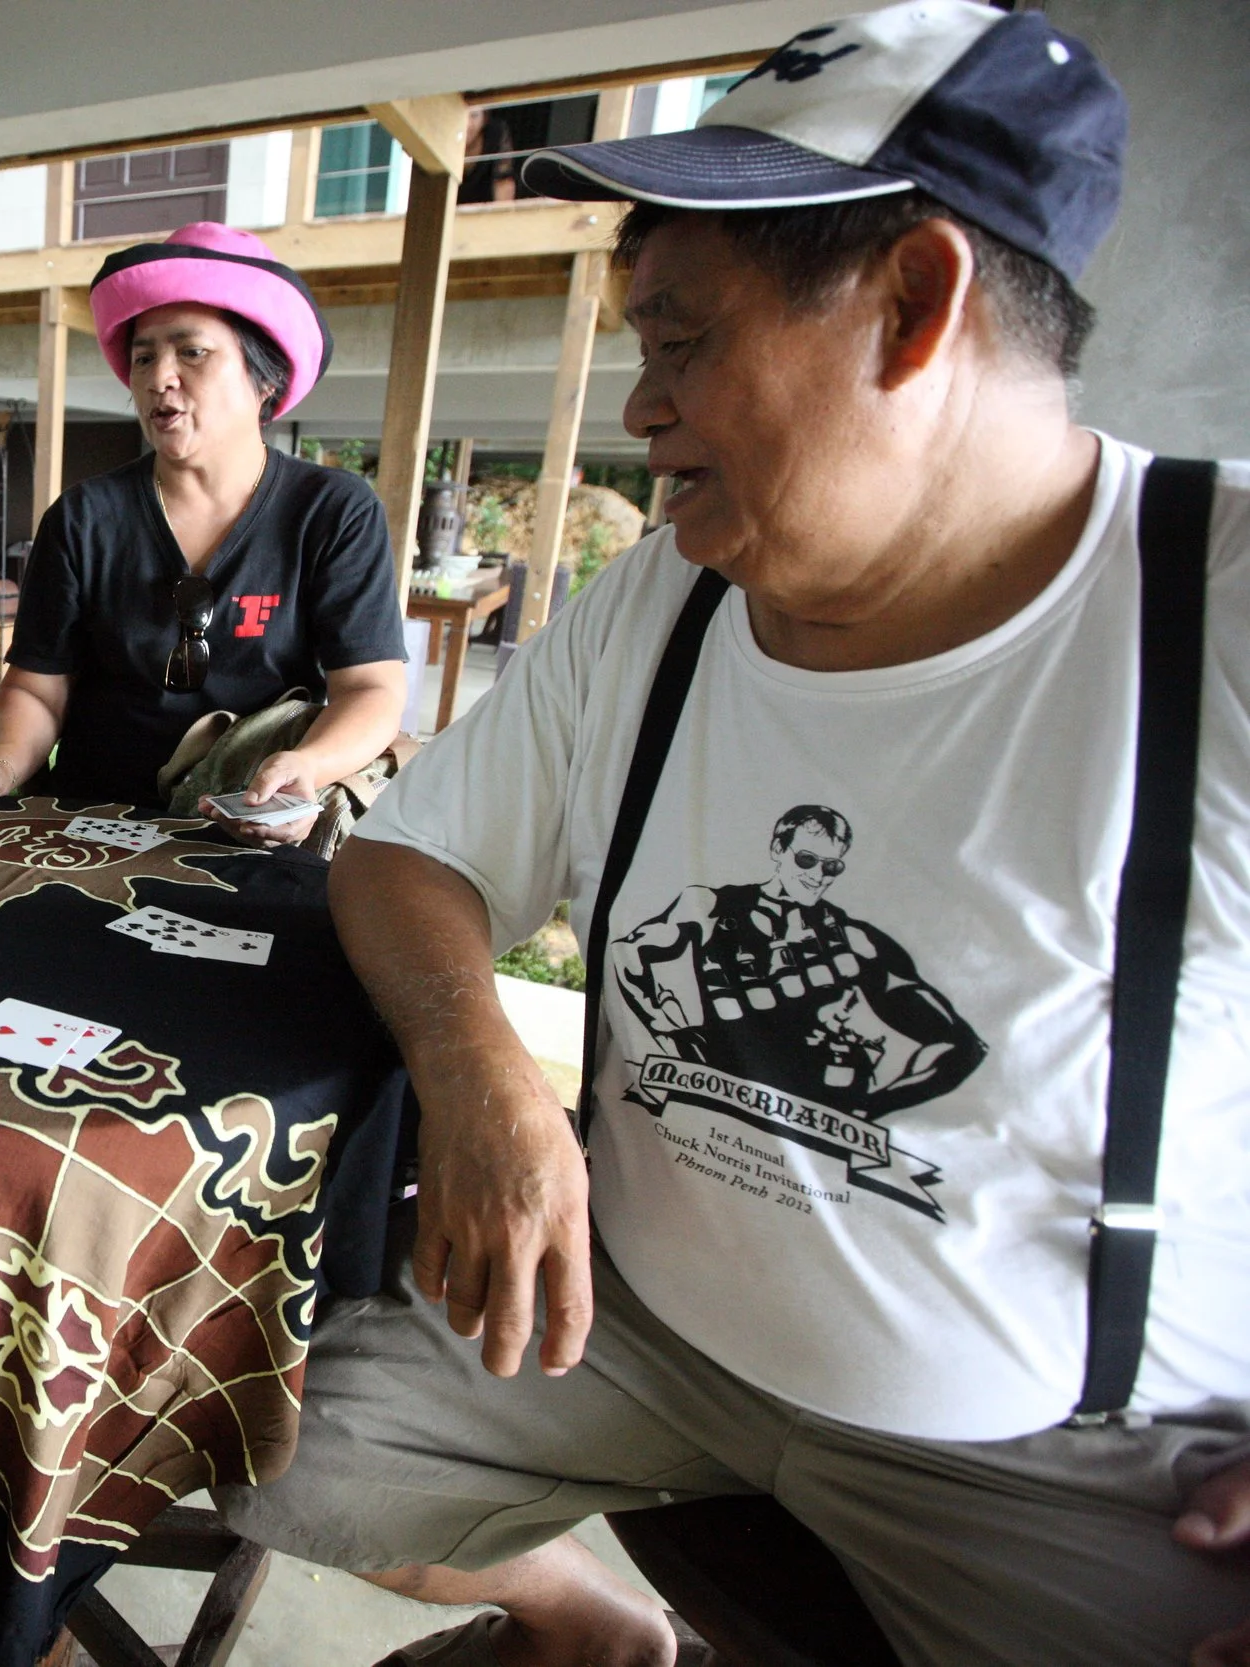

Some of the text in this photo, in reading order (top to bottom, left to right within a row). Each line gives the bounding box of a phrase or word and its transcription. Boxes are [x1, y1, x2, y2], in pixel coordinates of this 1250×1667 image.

[654, 1122, 851, 1204] Chuck Norris Invitational
[708, 1127, 785, 1168] 1st Annual
[675, 1152, 813, 1215] Phnom Penh 2012
